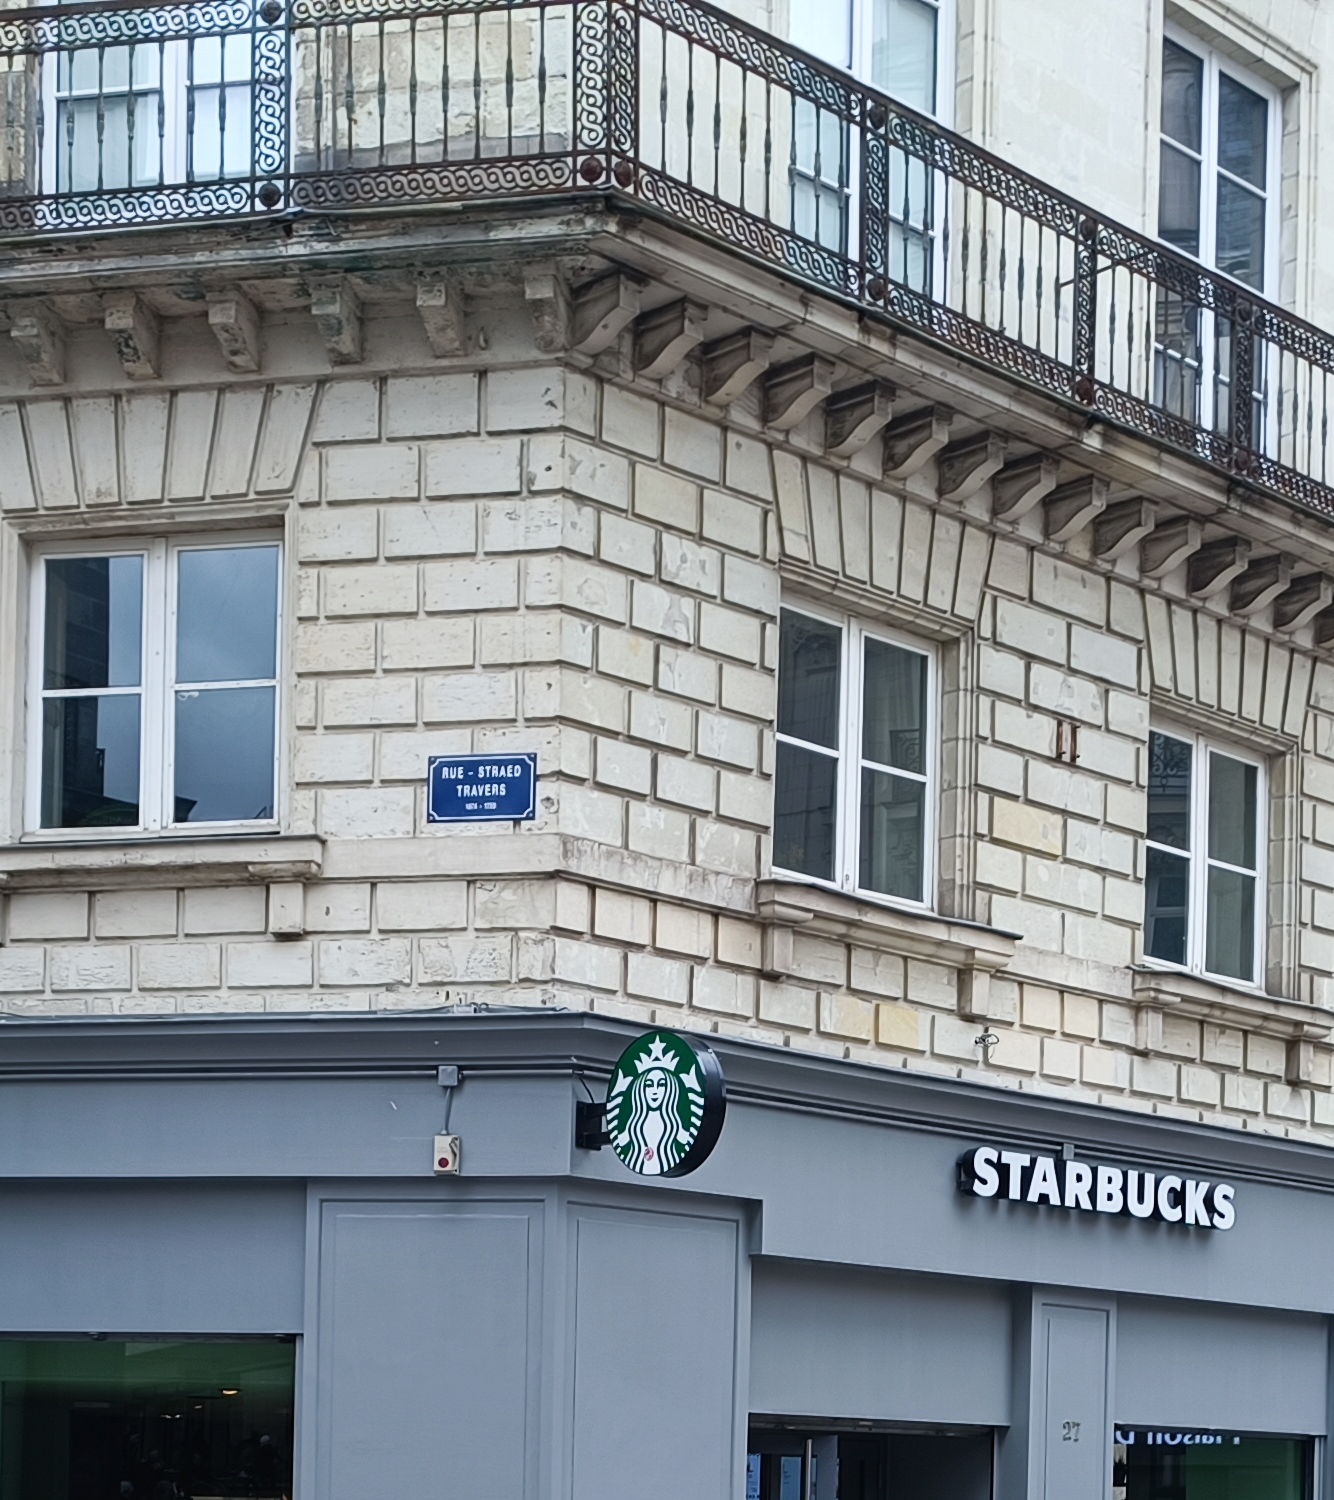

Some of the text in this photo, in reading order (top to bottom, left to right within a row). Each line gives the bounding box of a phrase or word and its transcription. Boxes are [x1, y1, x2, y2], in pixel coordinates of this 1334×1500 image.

[442, 766, 464, 779] RUE
[477, 764, 522, 778] STRAED
[456, 783, 507, 798] TRAVERS
[972, 1146, 1236, 1230] STARBUCKS
[1062, 1421, 1081, 1443] 27
